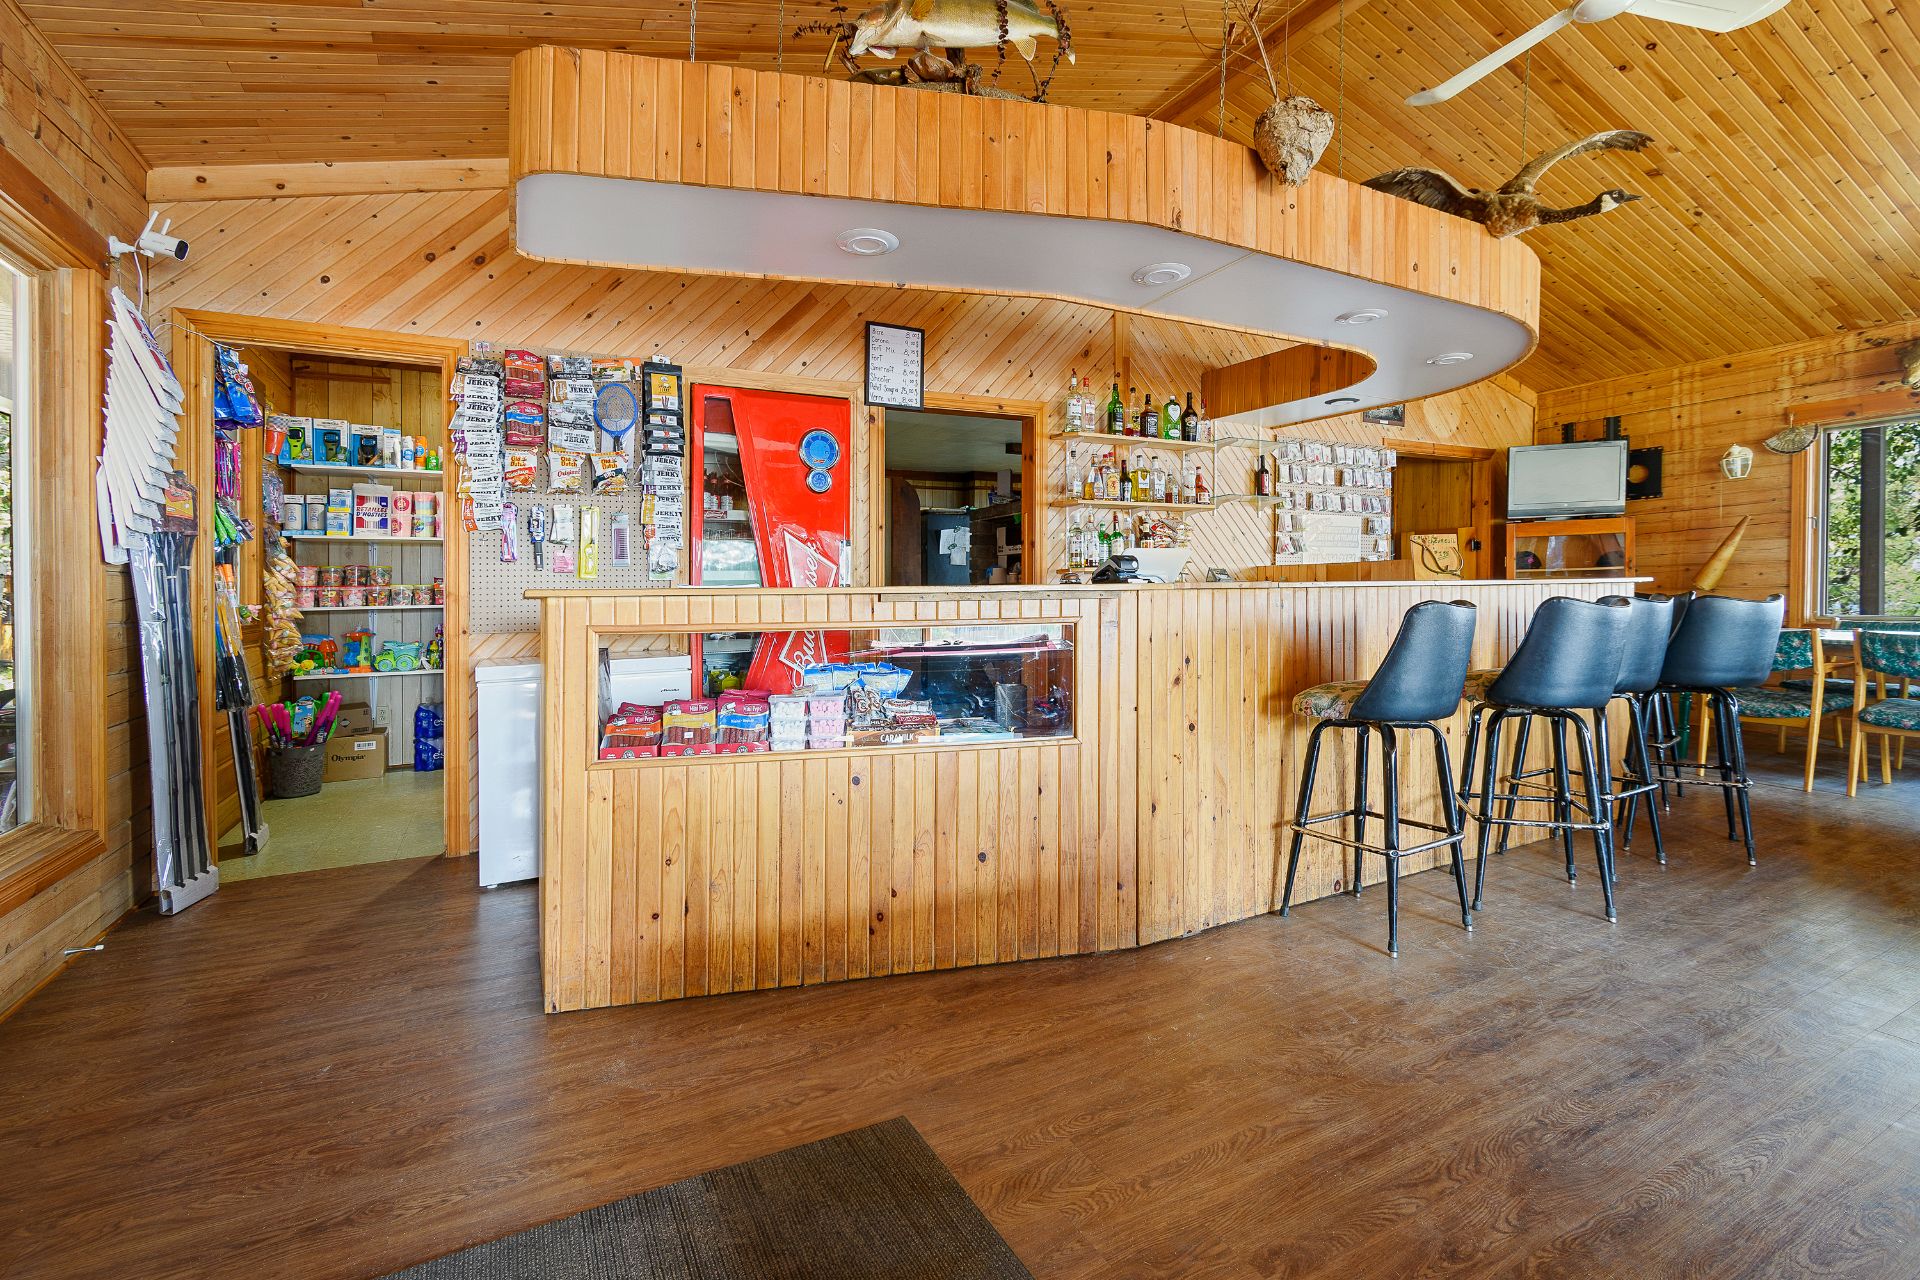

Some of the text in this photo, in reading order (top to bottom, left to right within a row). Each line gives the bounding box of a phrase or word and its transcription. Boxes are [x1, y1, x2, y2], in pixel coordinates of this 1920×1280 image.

[467, 379, 495, 387] JERKY
[467, 403, 495, 412] JERKY
[564, 436, 589, 444] JERKY
[656, 470, 680, 478] JERKY
[880, 733, 915, 743] CARAMILK
[331, 754, 366, 762] Olympia
